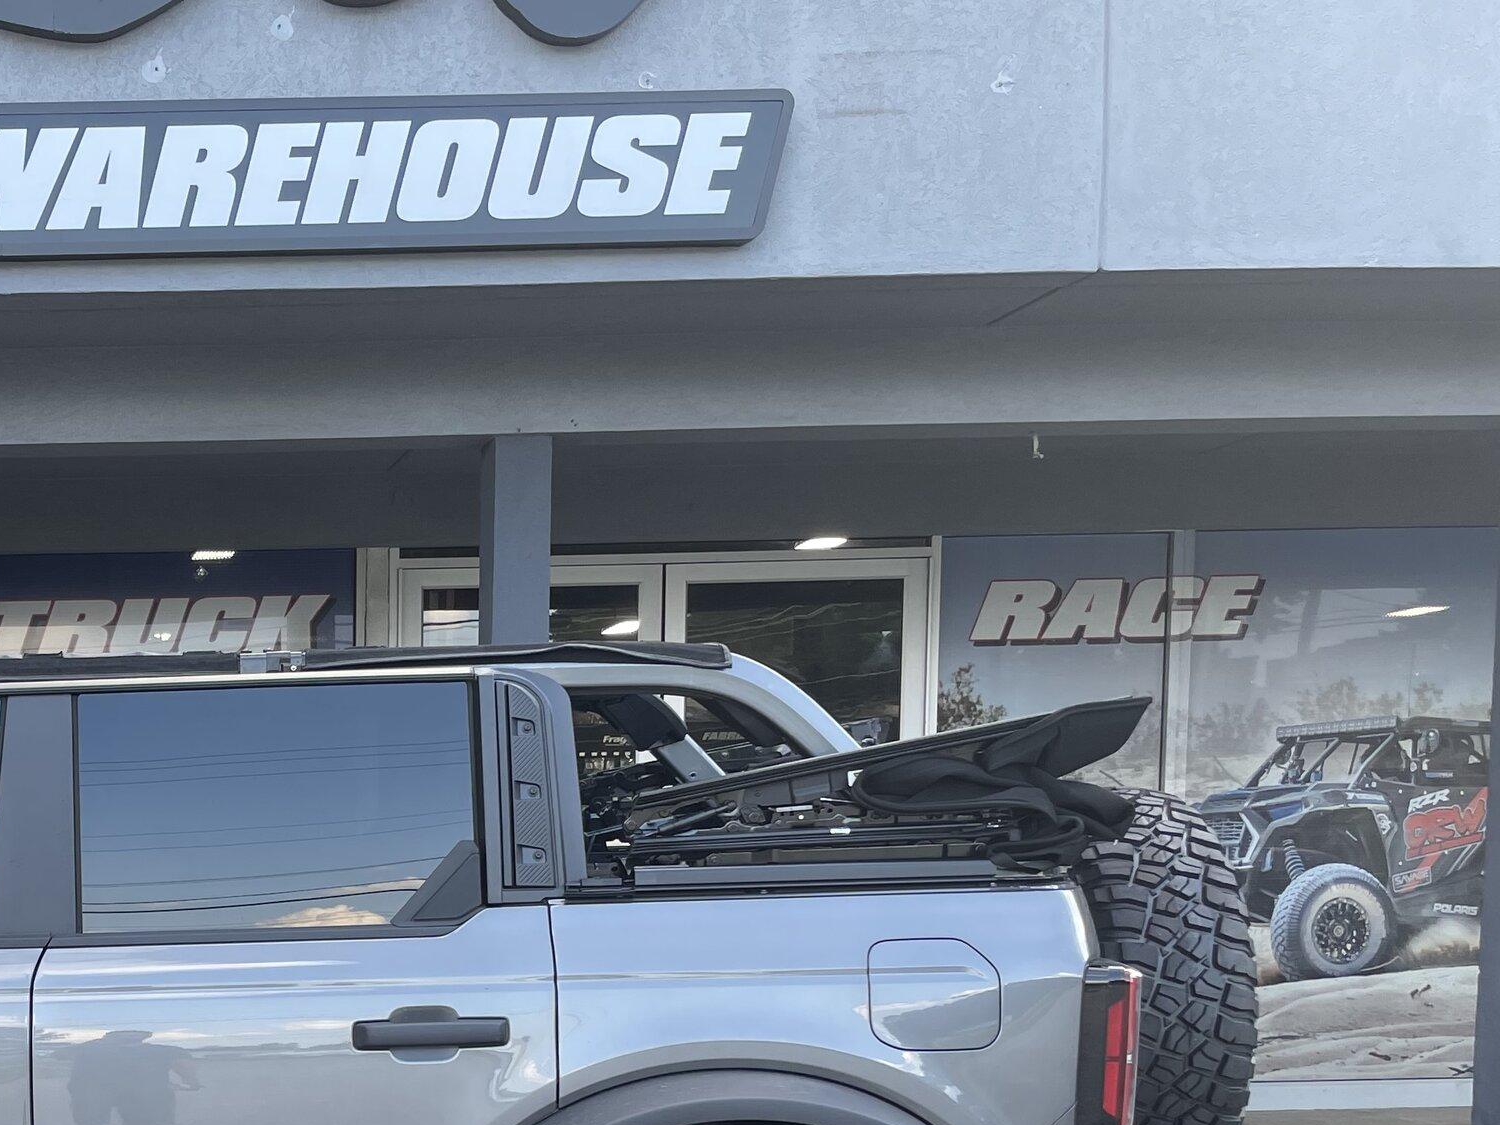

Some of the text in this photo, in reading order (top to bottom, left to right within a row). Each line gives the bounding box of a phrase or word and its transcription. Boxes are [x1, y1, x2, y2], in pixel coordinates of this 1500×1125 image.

[970, 575, 1264, 644] RACE
[1408, 788, 1450, 813] RZR
[1433, 902, 1479, 916] POLARIS
